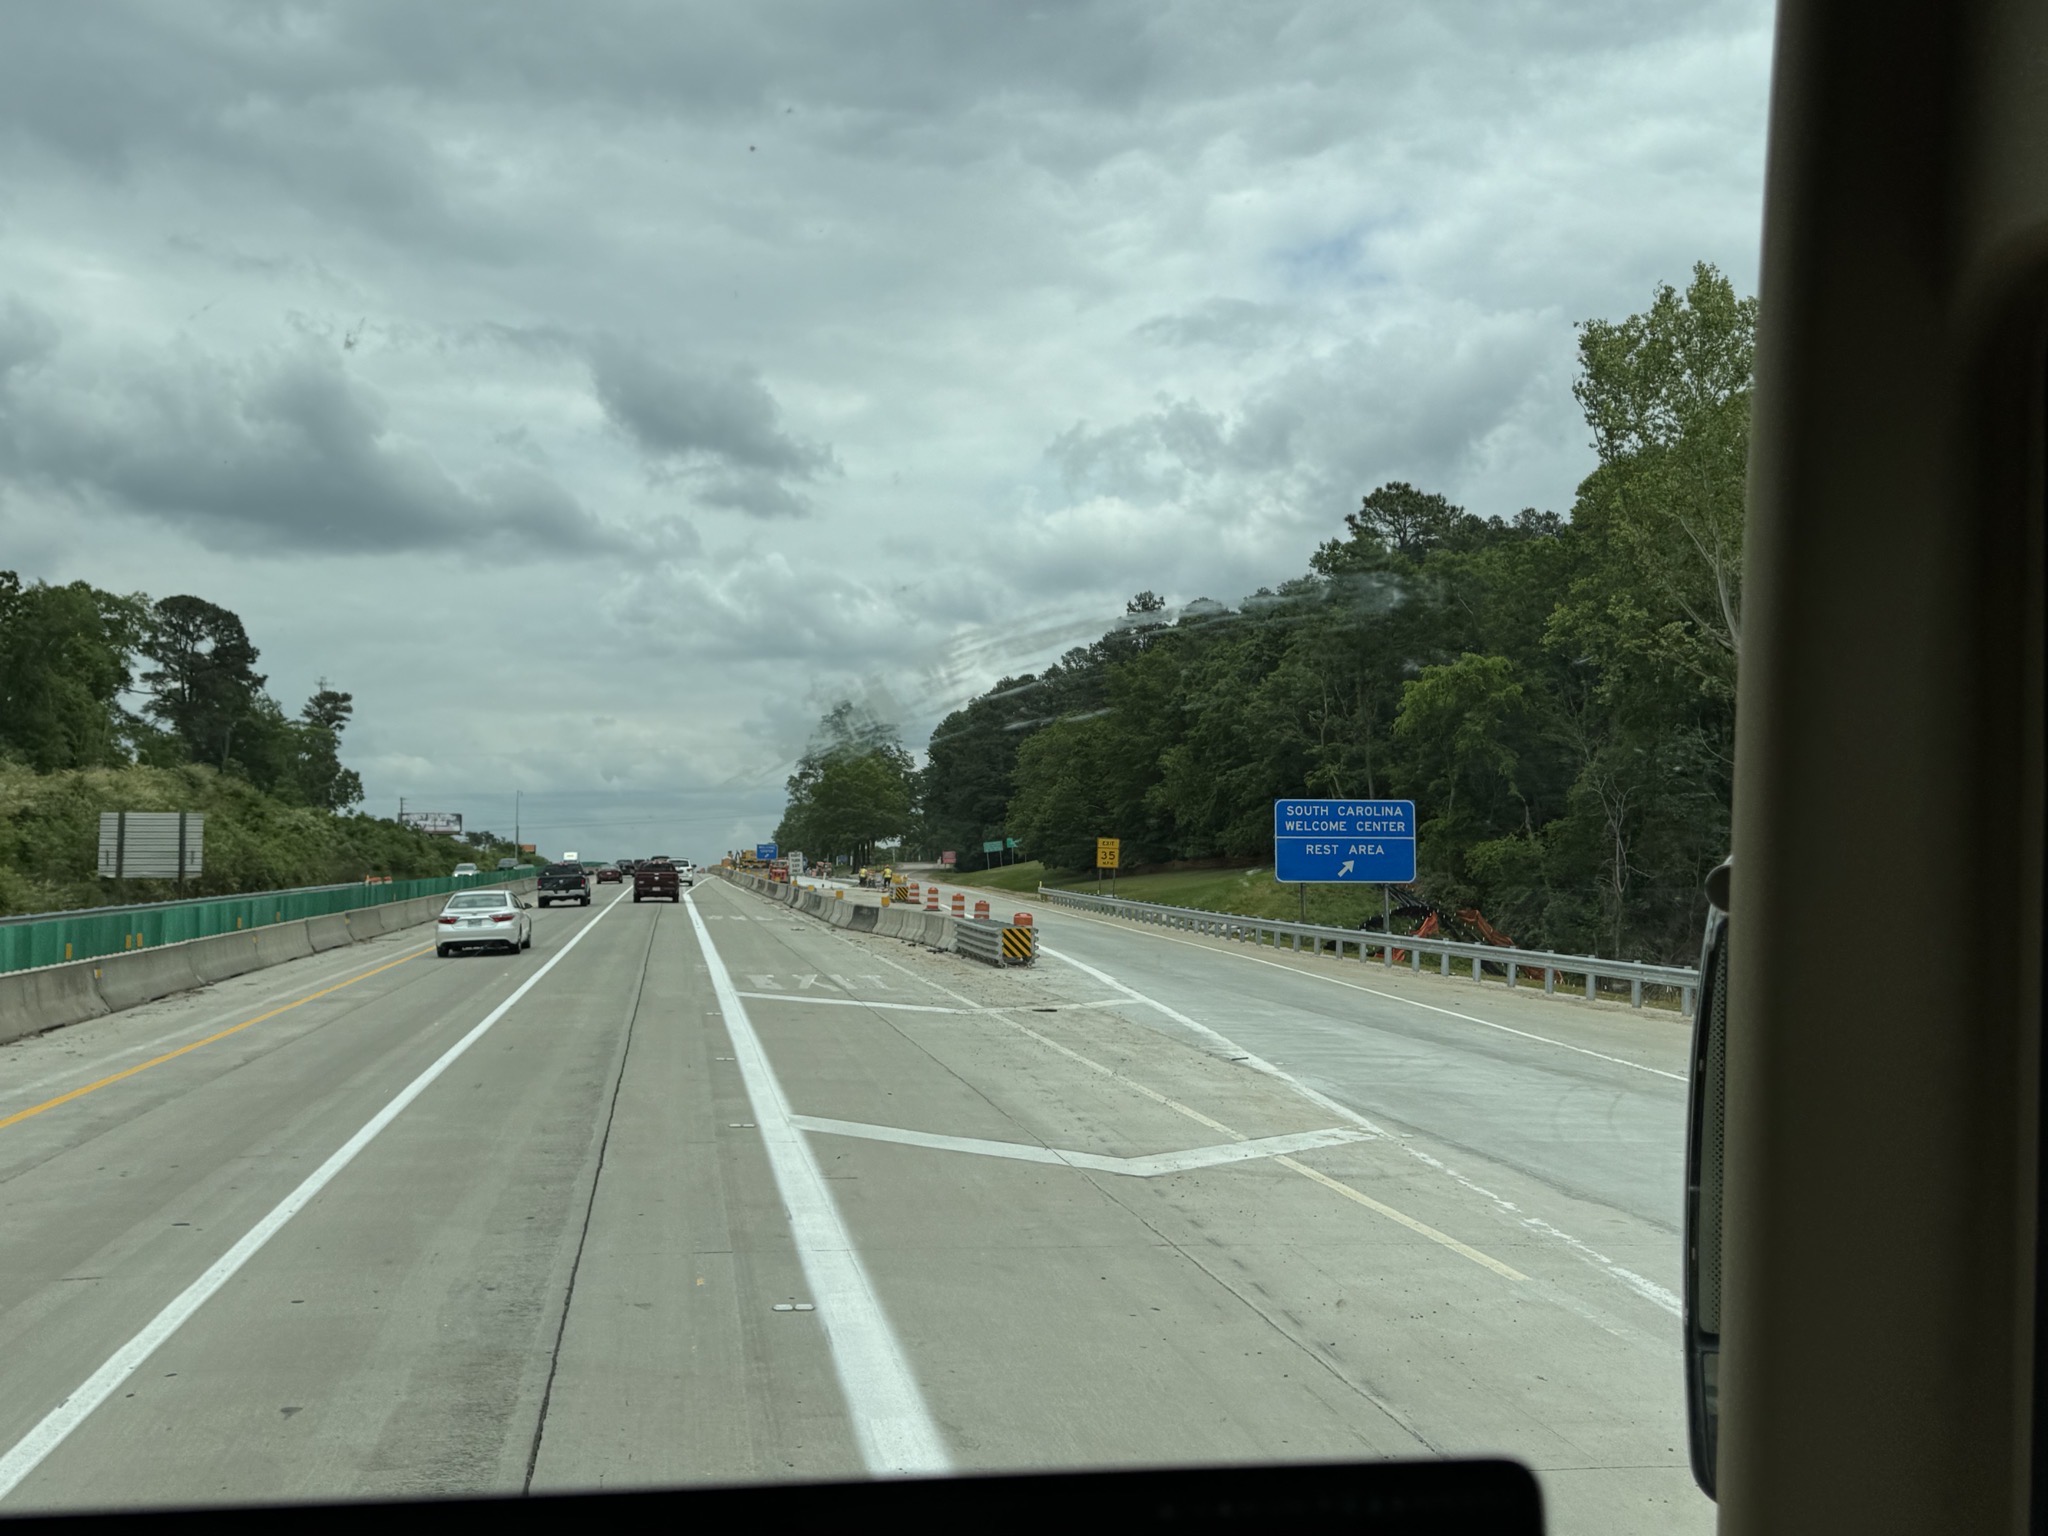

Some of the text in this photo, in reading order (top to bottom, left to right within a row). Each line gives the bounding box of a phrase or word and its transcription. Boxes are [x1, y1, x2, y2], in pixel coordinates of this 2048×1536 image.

[1286, 805, 1403, 817] SOUTH CAROLINA
[1285, 820, 1405, 832] WELCOME CENTER
[1305, 844, 1385, 855] REST AREA
[1101, 851, 1115, 860] 35
